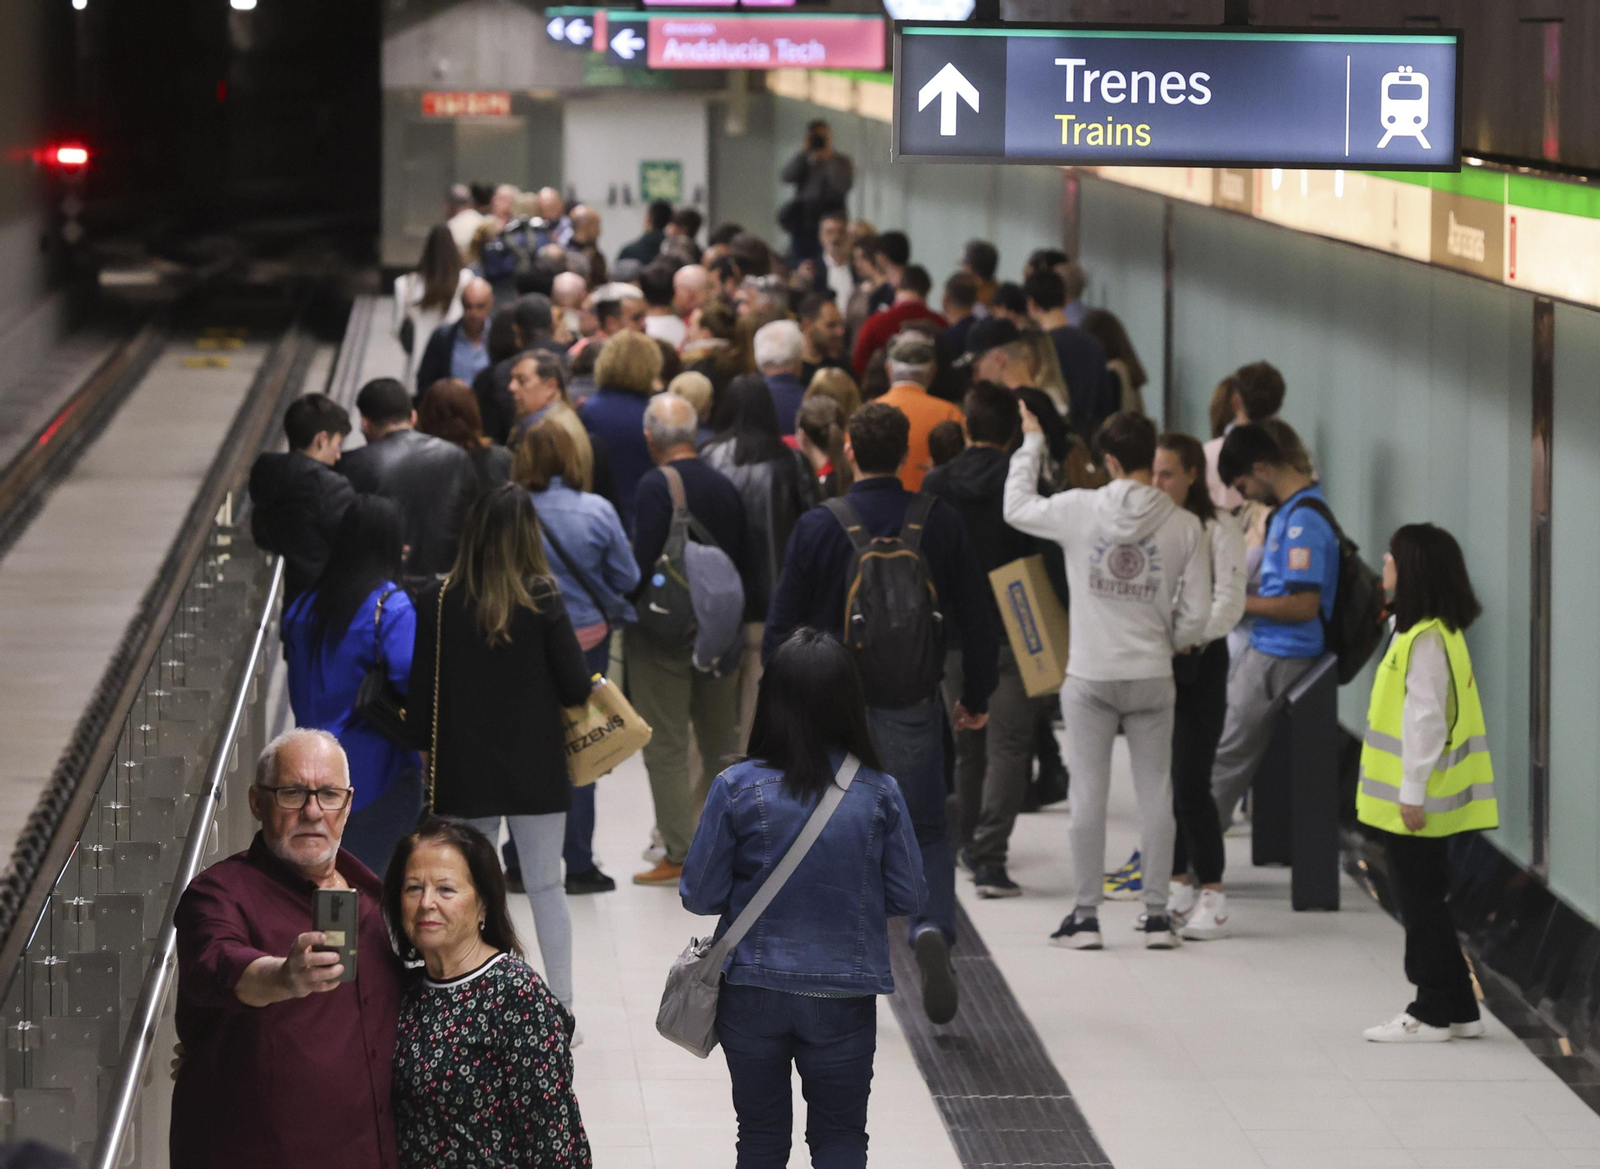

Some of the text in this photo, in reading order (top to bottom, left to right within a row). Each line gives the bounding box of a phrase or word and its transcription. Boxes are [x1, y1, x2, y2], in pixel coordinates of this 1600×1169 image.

[773, 38, 827, 63] Tech
[1054, 57, 1213, 106] Trenes
[1053, 113, 1152, 147] Trains
[563, 714, 626, 757] TEZENIS
